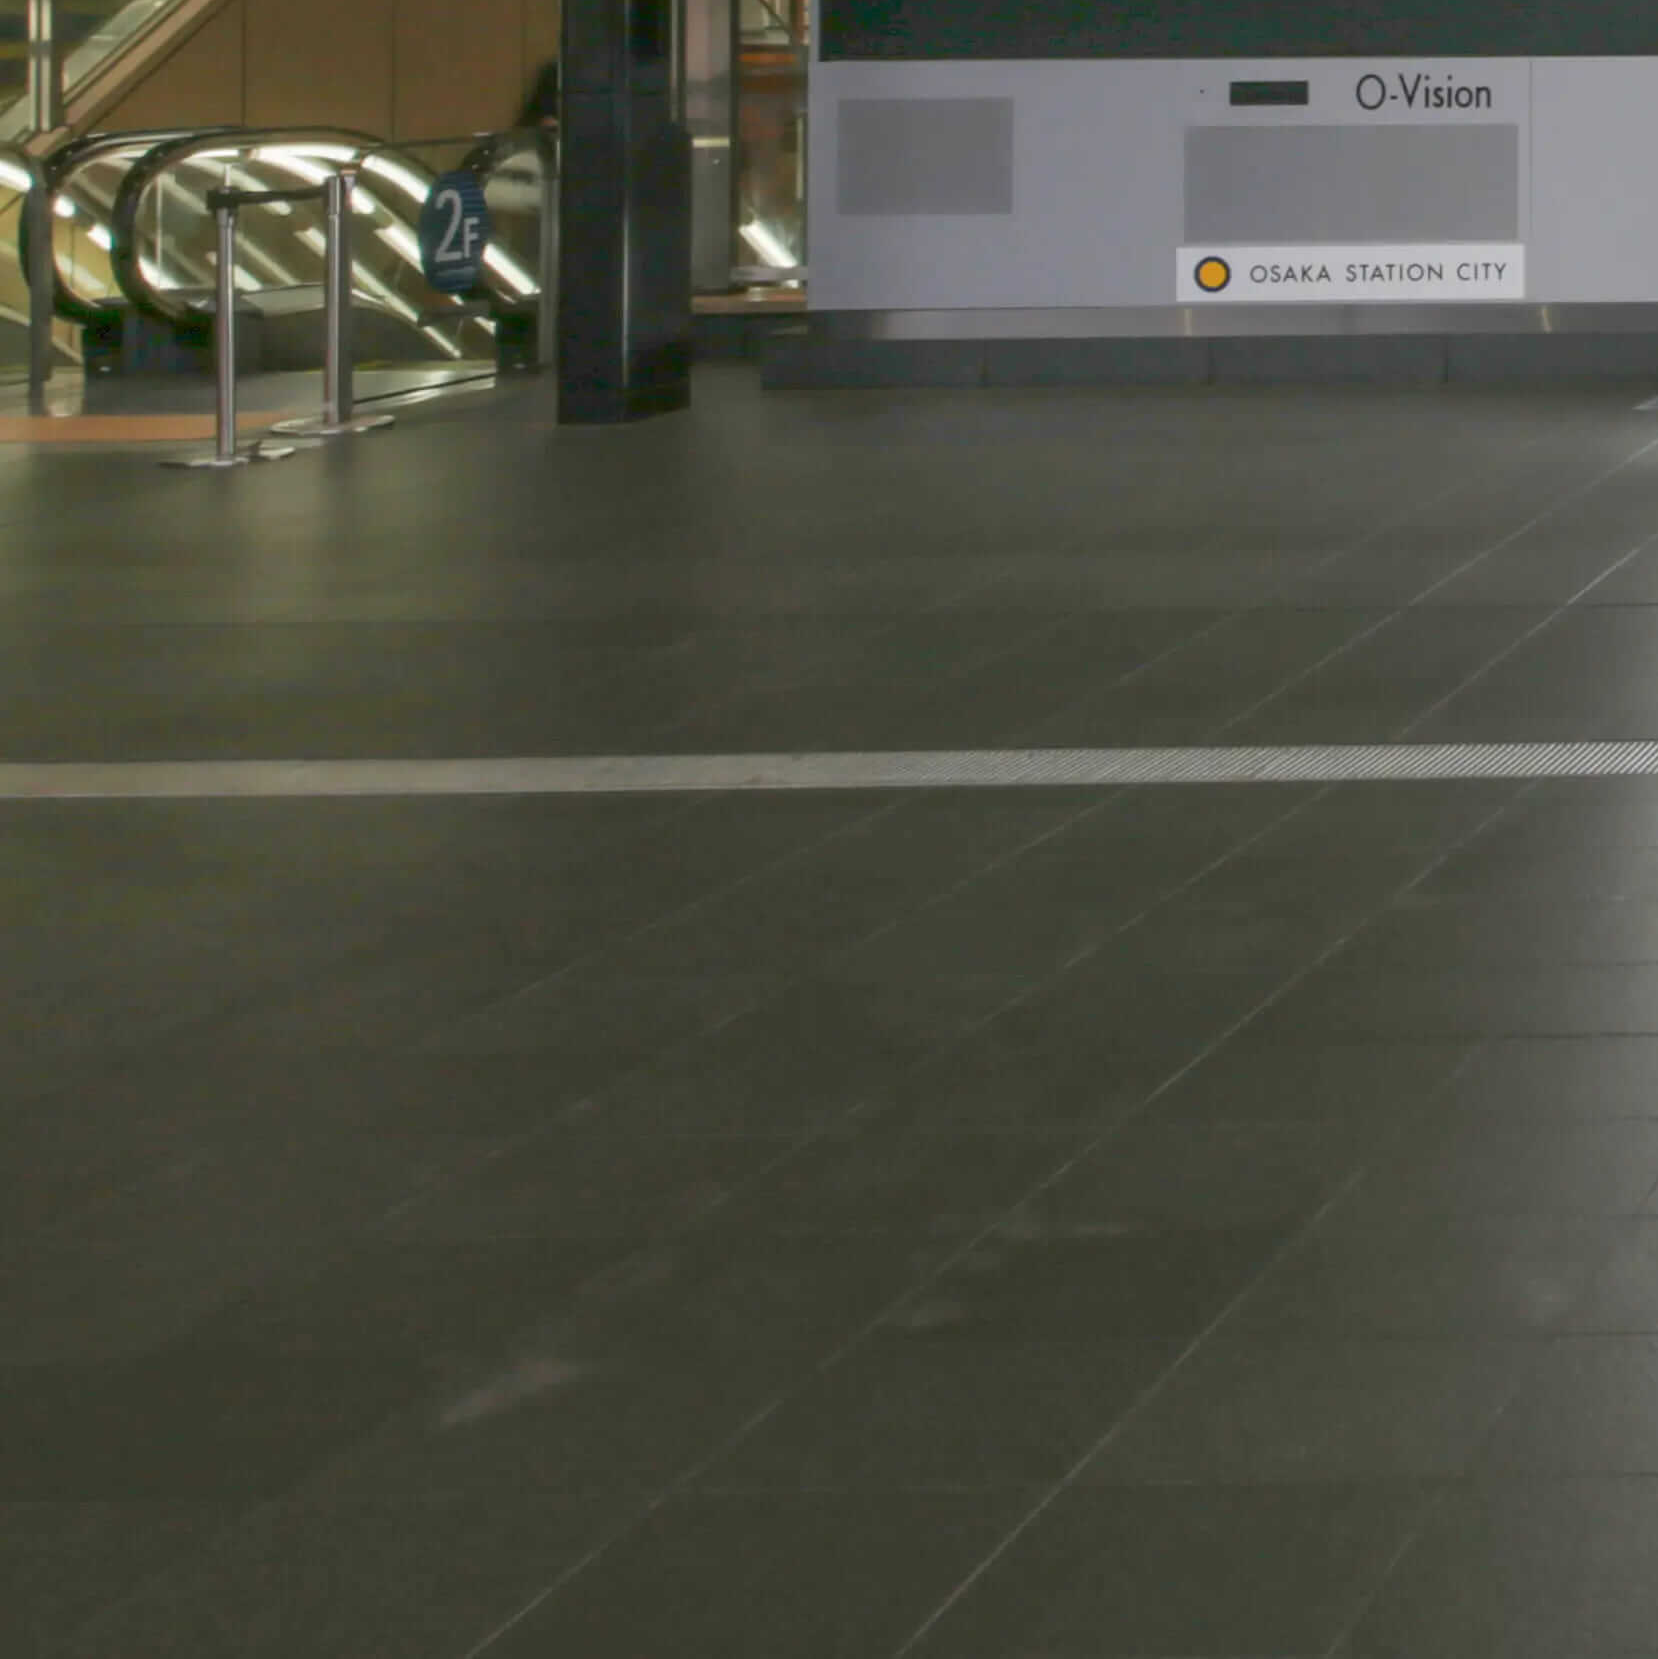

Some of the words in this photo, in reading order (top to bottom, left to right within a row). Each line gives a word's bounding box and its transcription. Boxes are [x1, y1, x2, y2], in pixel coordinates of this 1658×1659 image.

[1356, 74, 1492, 110] O-Vision
[434, 188, 480, 263] 2F
[1250, 265, 1332, 284] OSAKA
[1346, 264, 1444, 283] STATION
[1457, 263, 1507, 282] CITY
